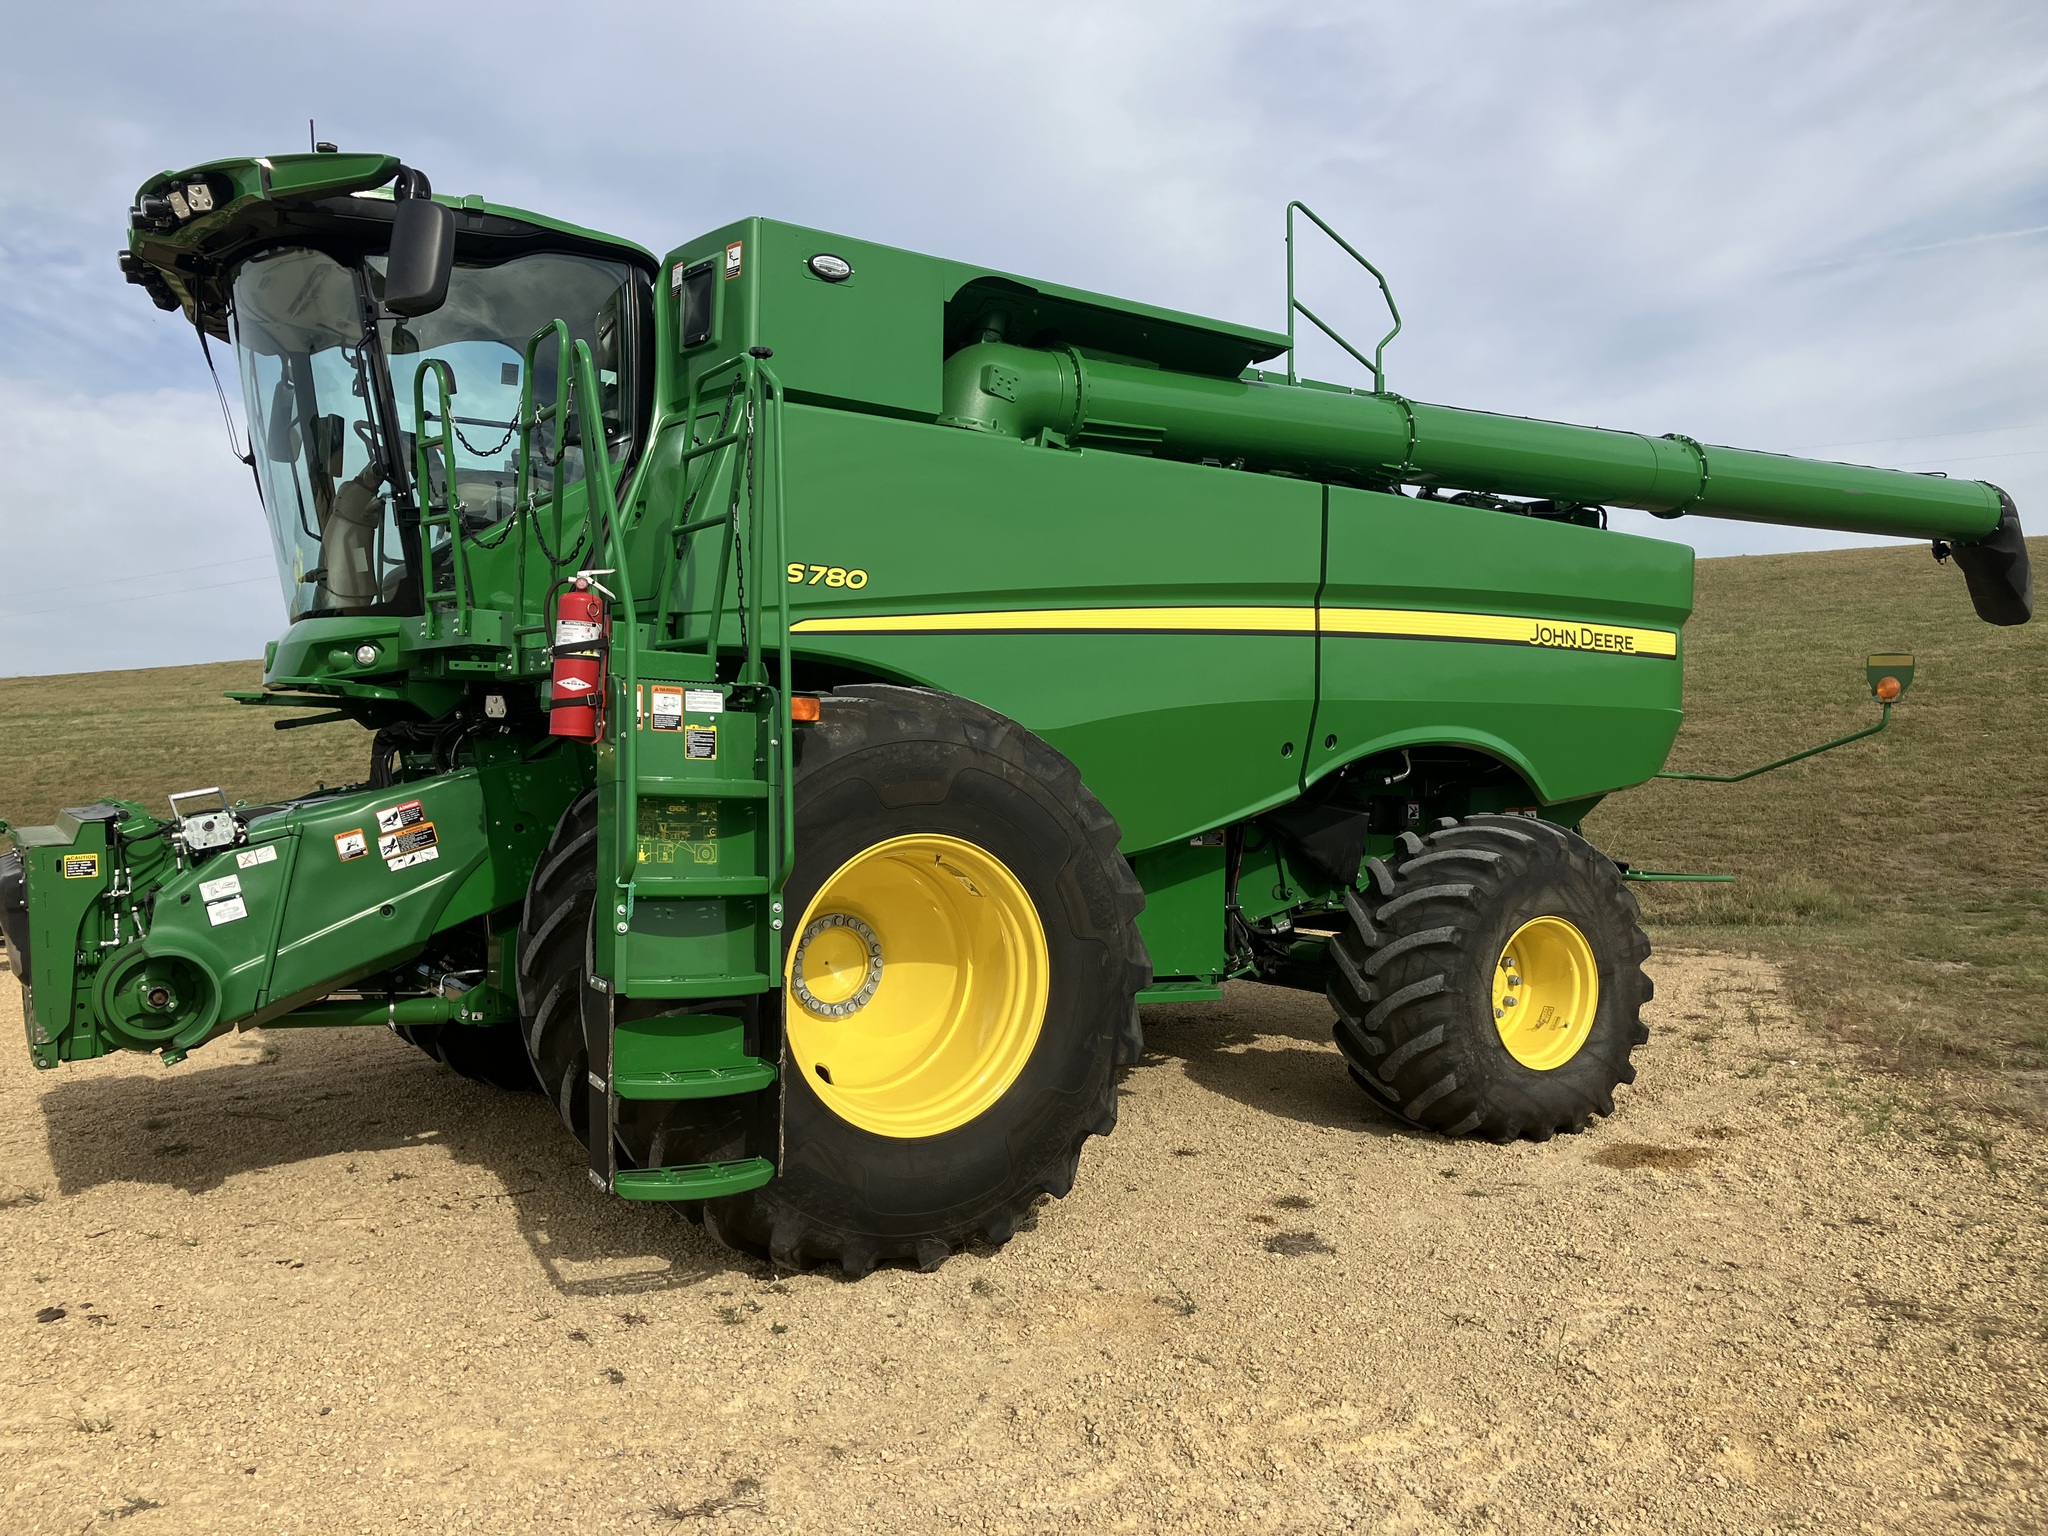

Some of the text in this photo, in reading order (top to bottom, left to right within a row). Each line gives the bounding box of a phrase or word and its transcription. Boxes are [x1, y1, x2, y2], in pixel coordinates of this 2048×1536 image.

[787, 562, 869, 590] S780
[1530, 623, 1634, 650] JOHN DEERE
